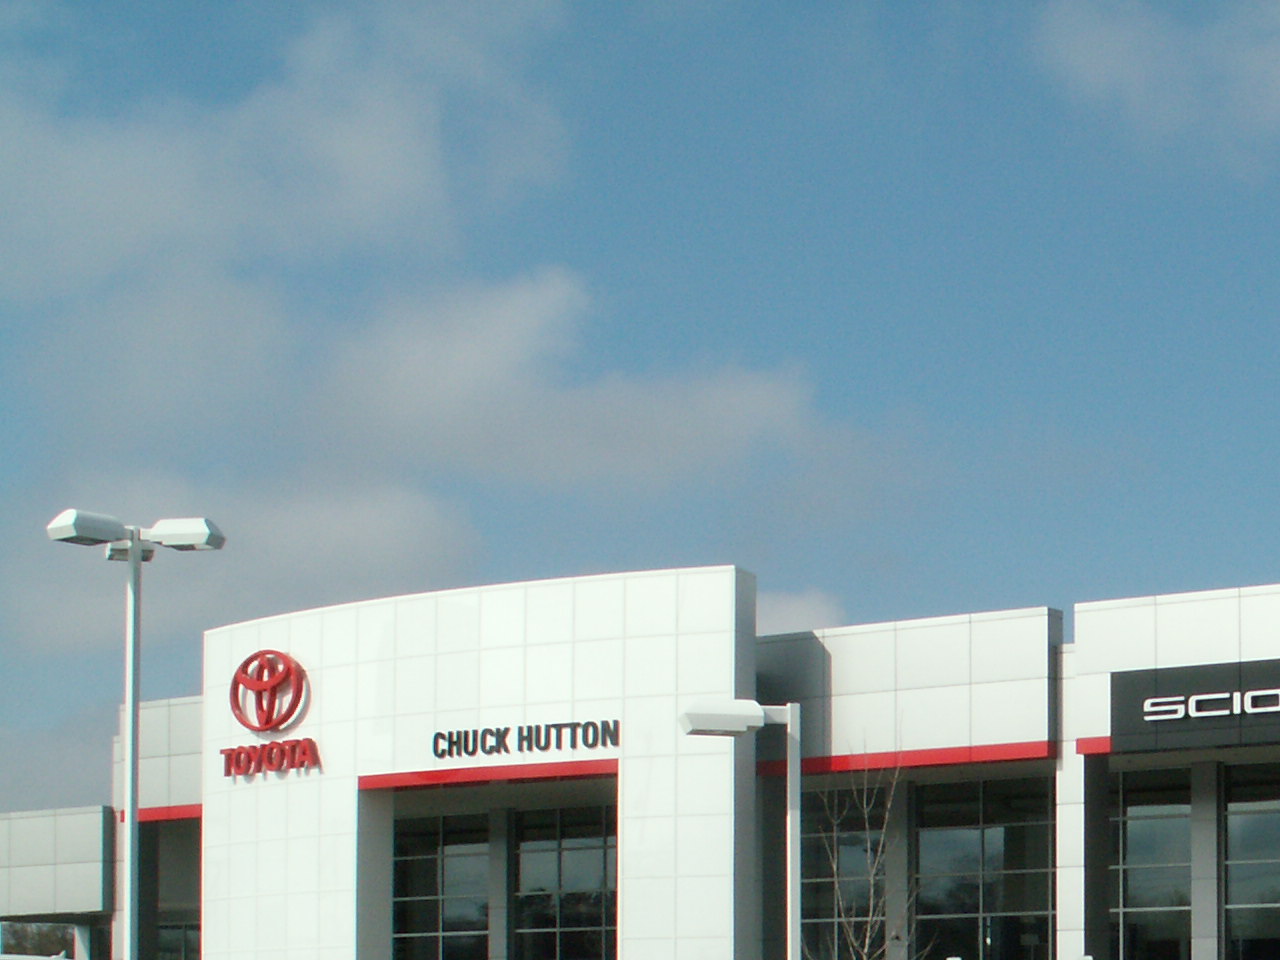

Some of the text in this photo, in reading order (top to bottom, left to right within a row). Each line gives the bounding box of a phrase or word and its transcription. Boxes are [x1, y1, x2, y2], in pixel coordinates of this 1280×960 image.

[220, 738, 321, 778] TOYOTA
[433, 720, 620, 758] CHUCK HUTTON
